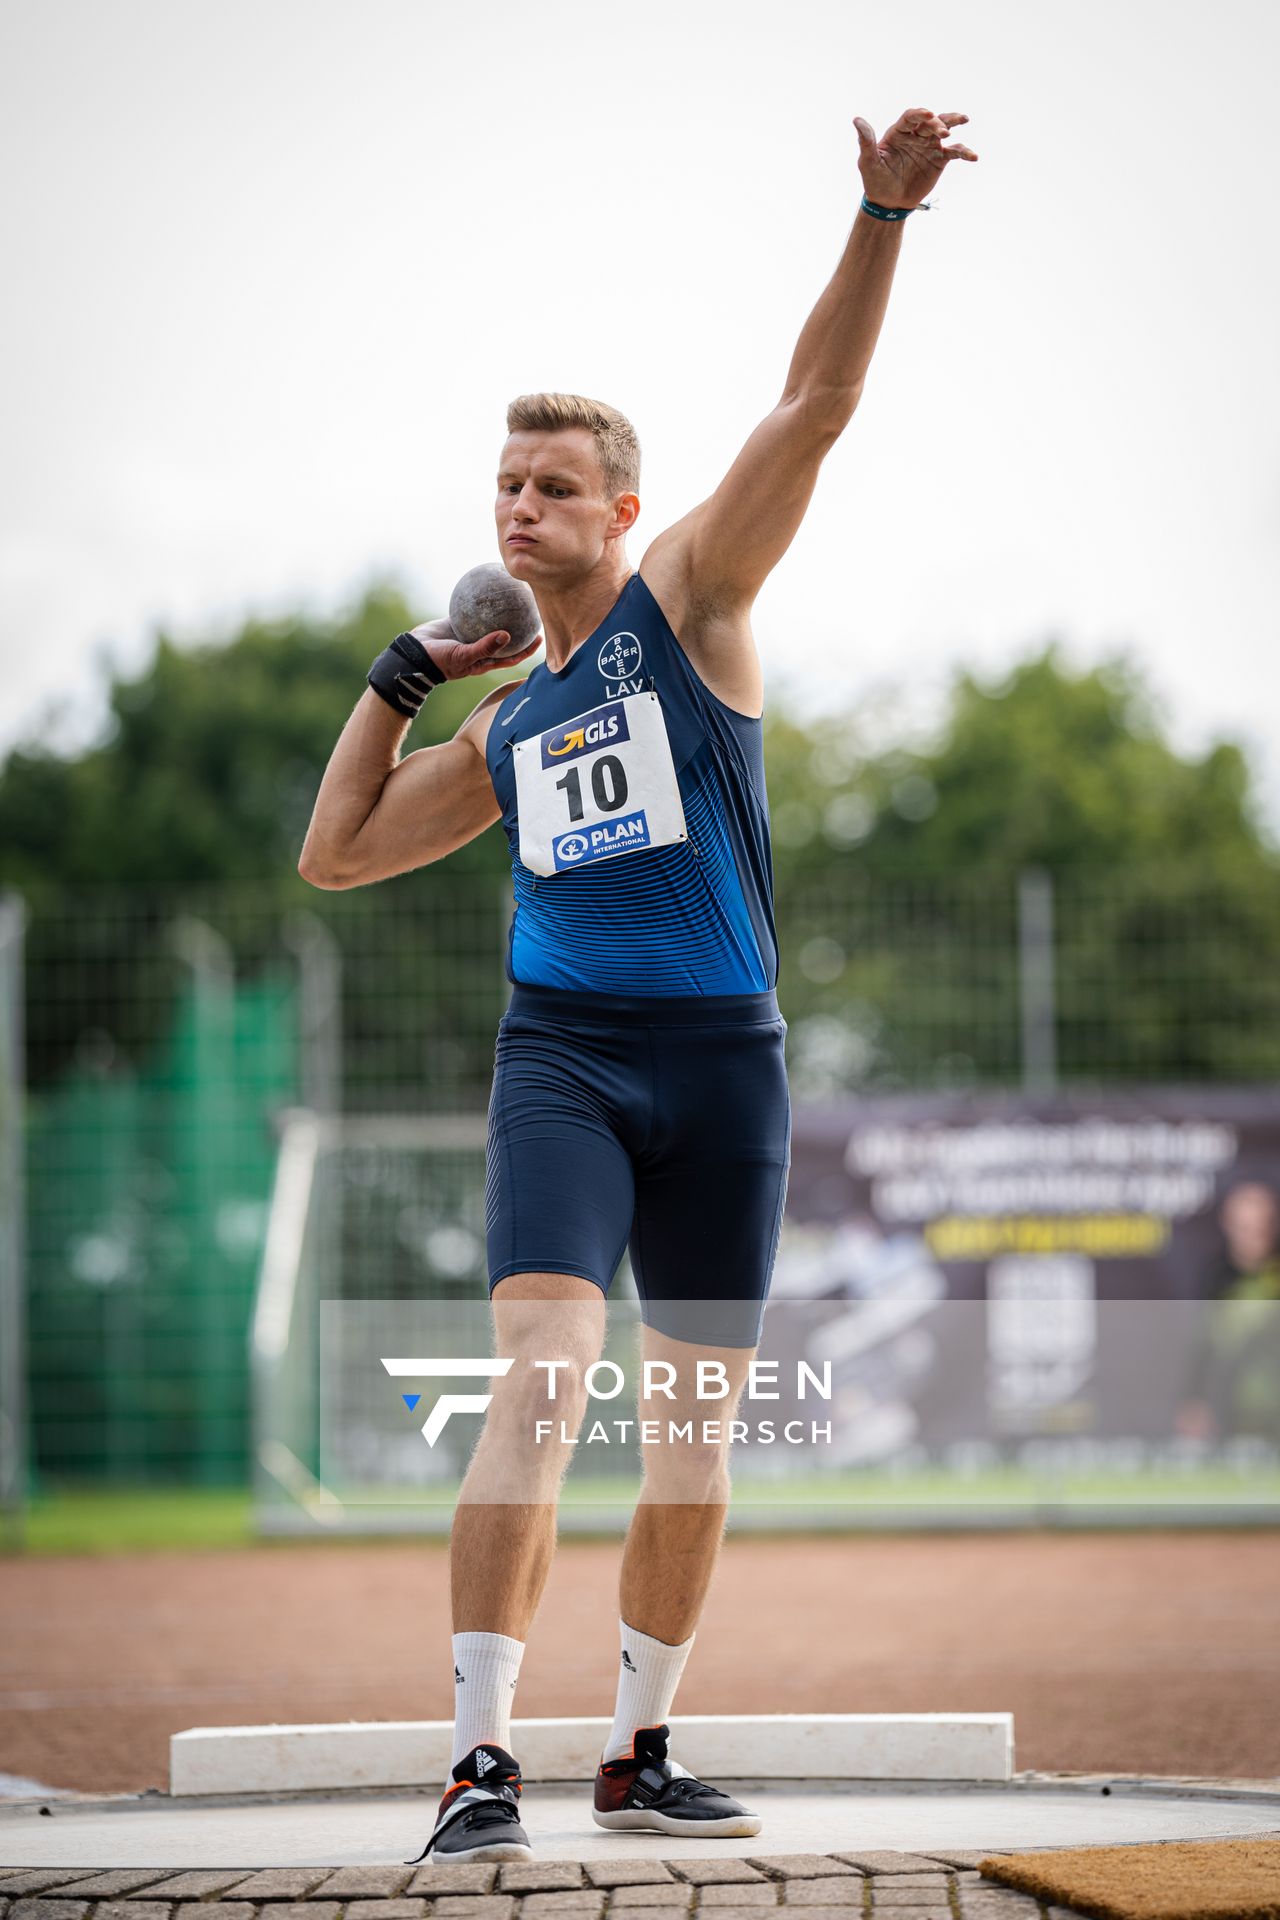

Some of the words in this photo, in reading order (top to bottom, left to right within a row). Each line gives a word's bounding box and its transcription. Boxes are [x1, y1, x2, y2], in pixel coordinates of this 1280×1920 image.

[601, 646, 638, 666] BAYER
[613, 636, 627, 676] BAYER
[605, 678, 643, 699] LAV
[585, 715, 619, 745] GLS
[556, 754, 629, 823] 10
[590, 818, 644, 847] PLAN
[593, 836, 646, 855] INTERNATIONAL
[475, 1749, 485, 1778] adidas
